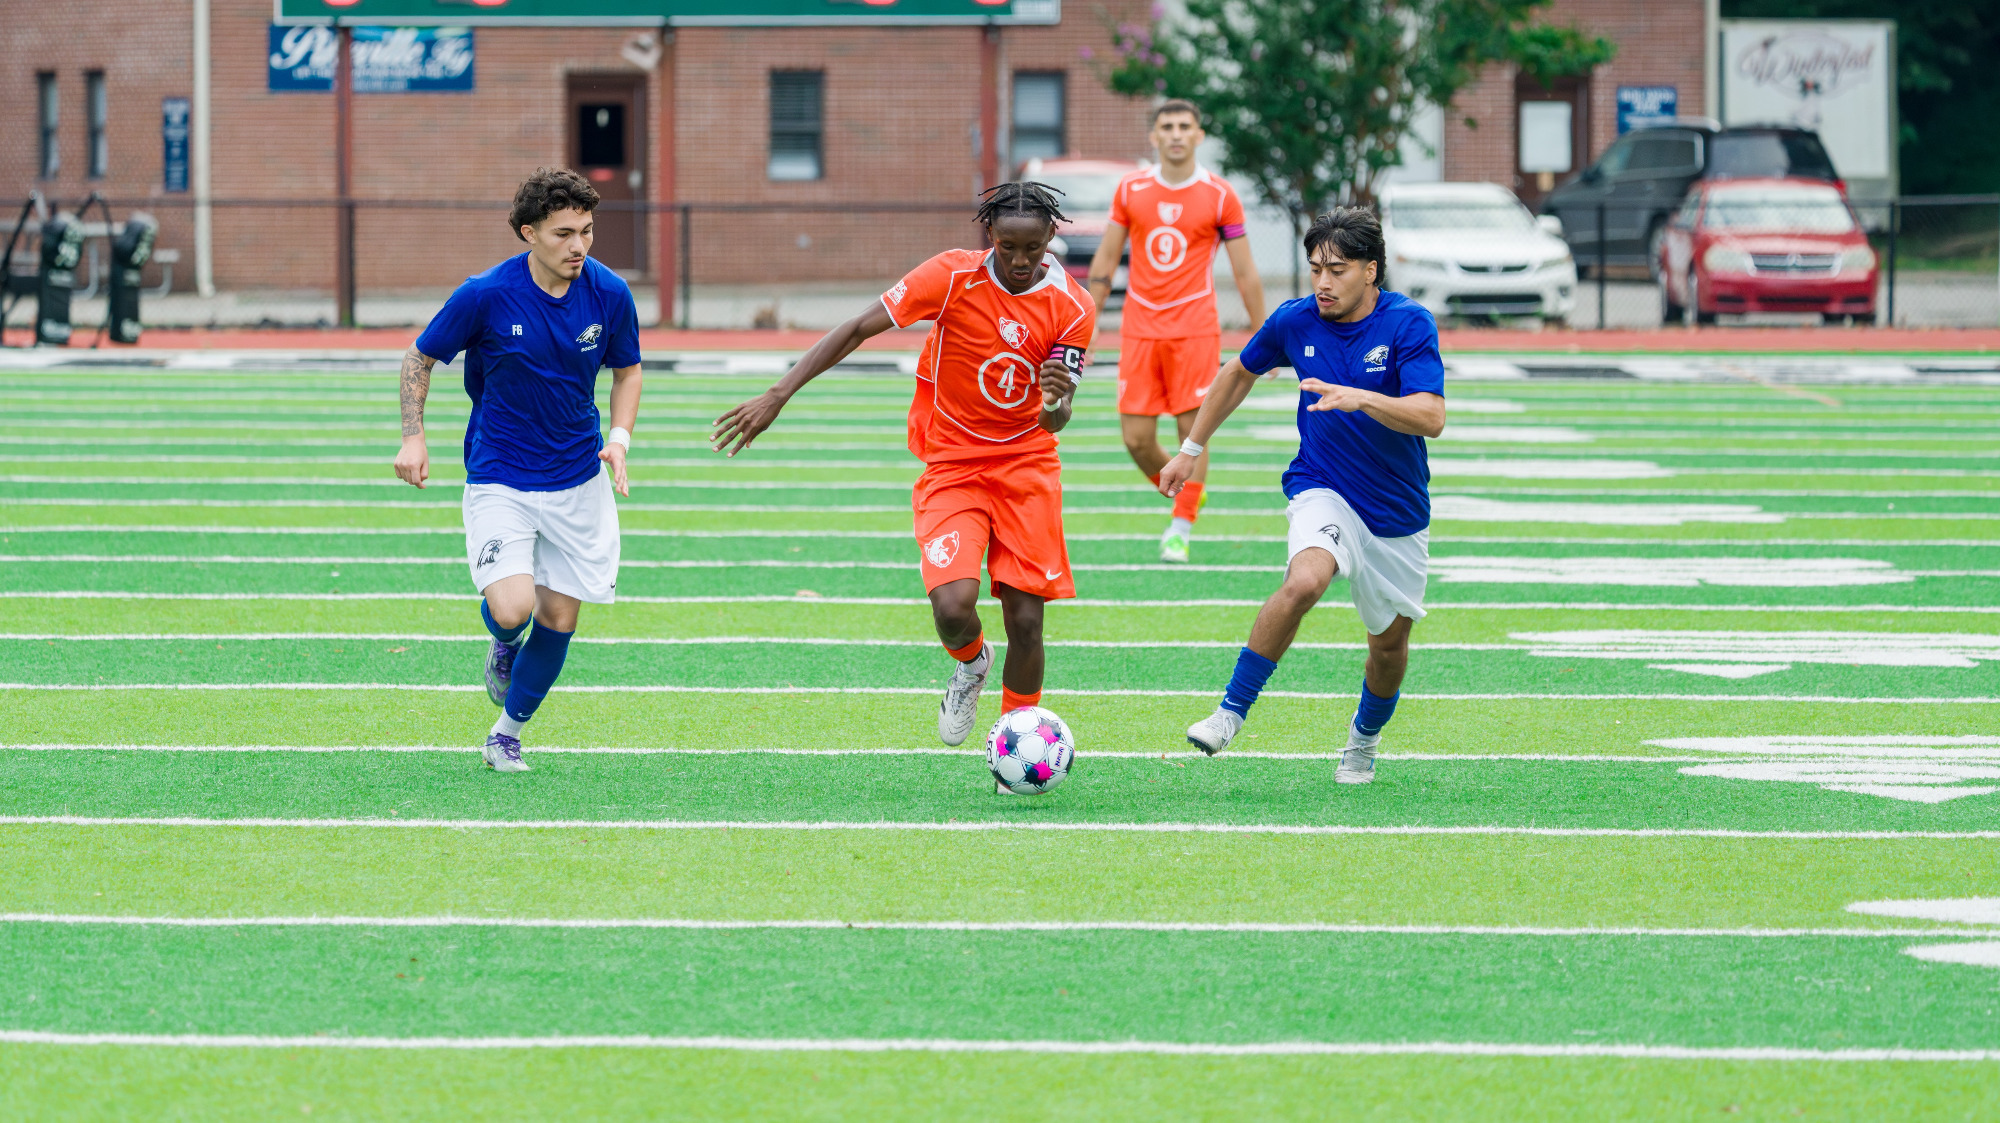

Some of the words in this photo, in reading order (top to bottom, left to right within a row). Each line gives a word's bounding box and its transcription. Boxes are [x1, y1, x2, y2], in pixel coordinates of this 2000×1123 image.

[270, 27, 425, 69] Pieville
[1158, 234, 1174, 264] 9
[512, 325, 523, 336] FG
[1065, 348, 1080, 369] C
[997, 364, 1016, 398] 4
